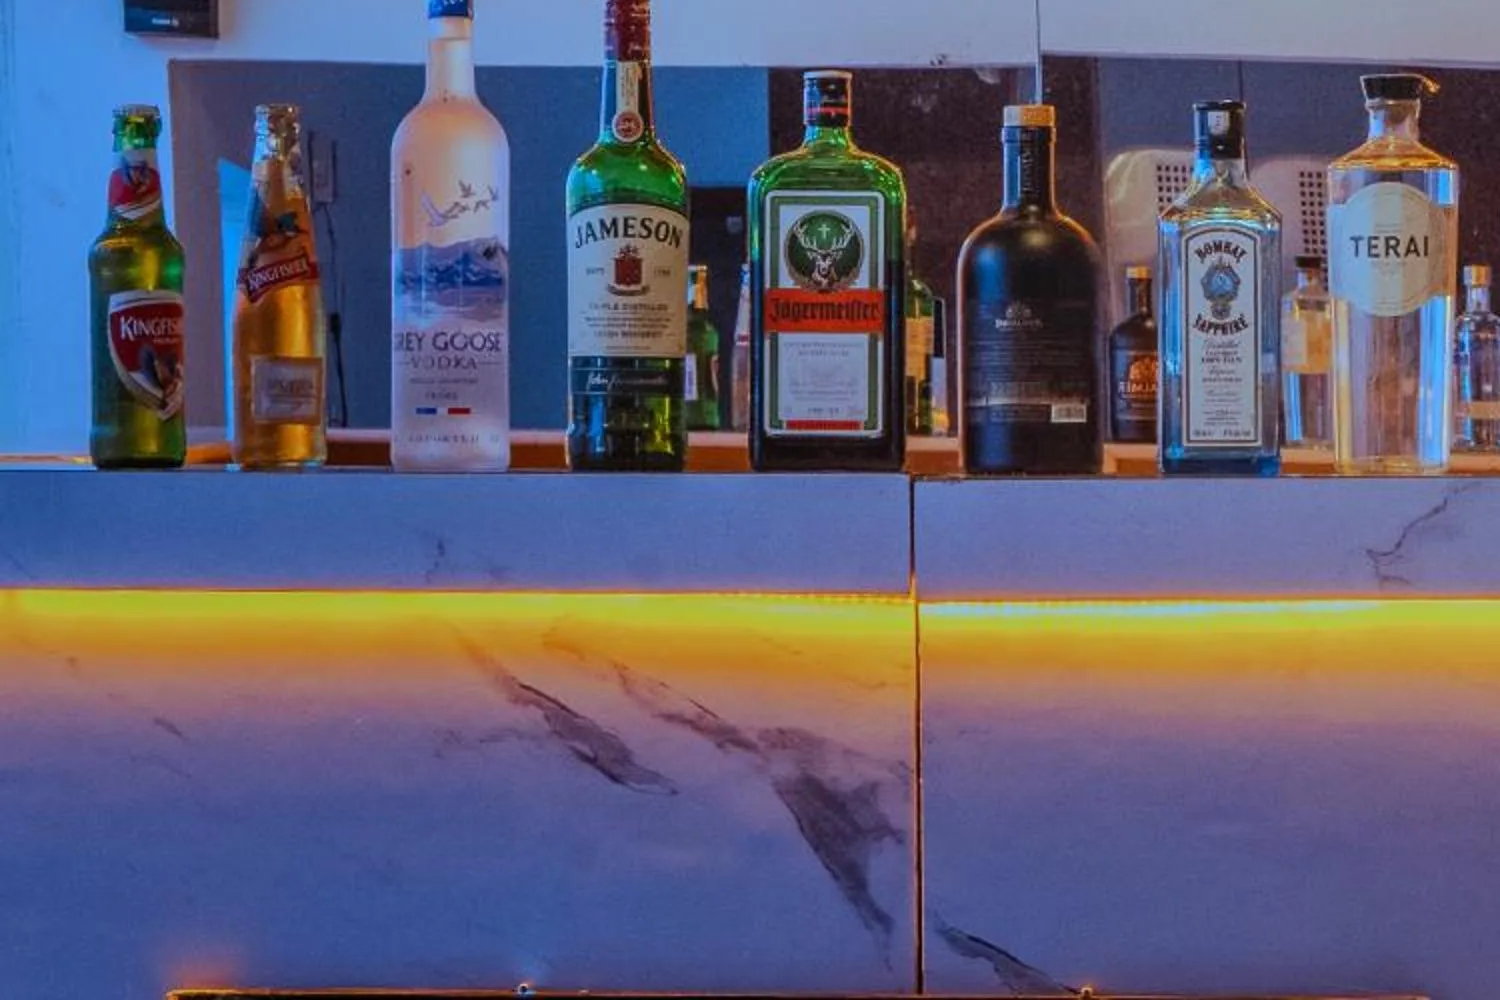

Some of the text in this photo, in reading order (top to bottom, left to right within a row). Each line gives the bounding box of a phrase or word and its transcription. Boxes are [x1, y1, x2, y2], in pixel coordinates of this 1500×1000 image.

[575, 215, 682, 249] JAMESON
[1194, 240, 1247, 264] BOMBAY
[1349, 234, 1429, 258] TERAI
[1192, 312, 1249, 336] SAPPHIRE
[432, 330, 503, 353] GOOSE
[410, 354, 478, 370] VODKA
